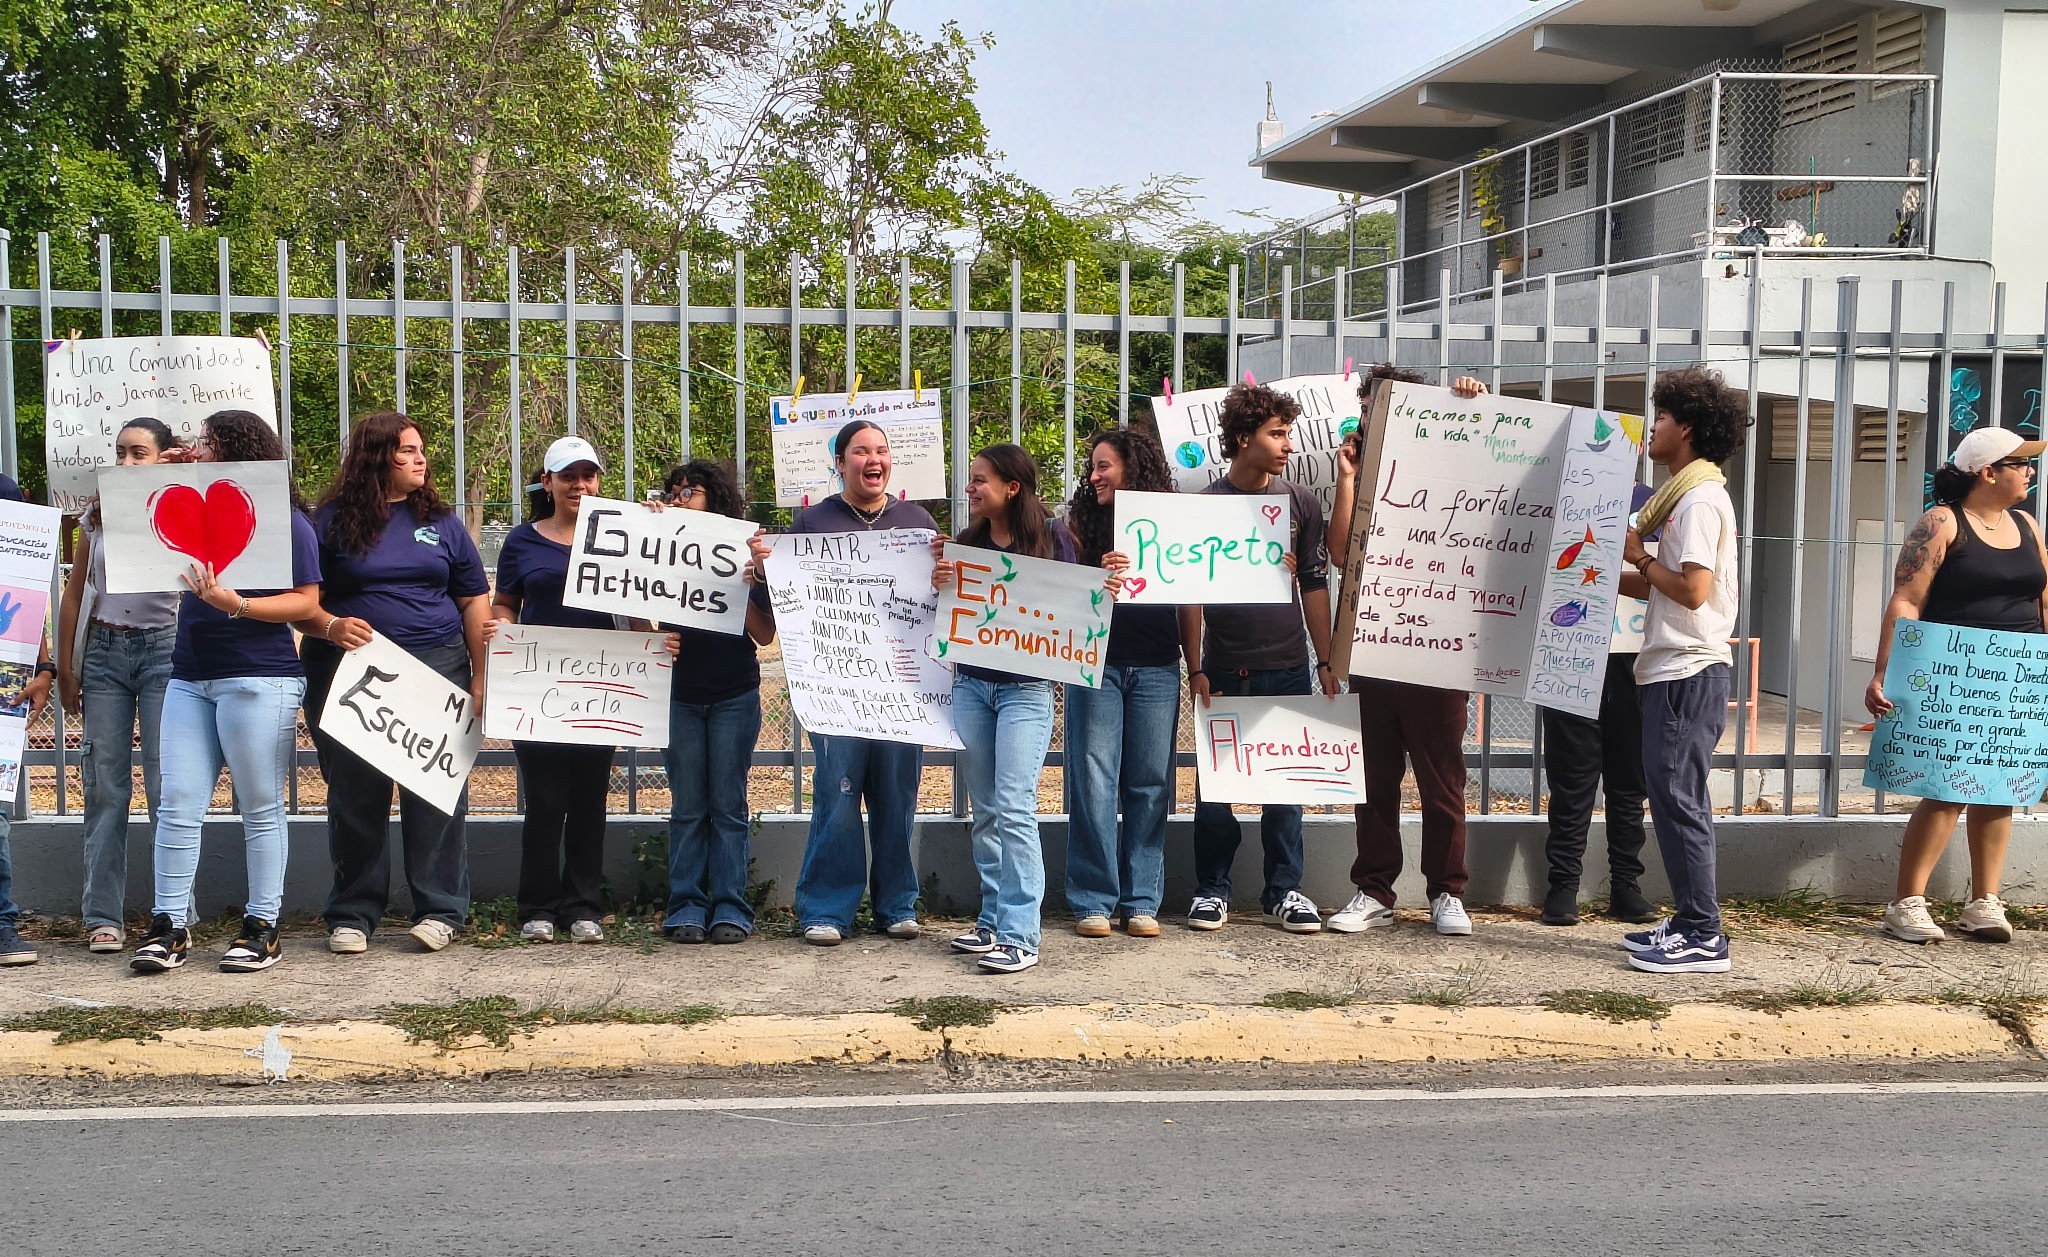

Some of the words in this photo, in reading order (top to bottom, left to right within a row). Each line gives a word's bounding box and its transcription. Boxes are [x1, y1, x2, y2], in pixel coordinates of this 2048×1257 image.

[70, 349, 115, 376] Una
[128, 346, 246, 375] Comunidad
[51, 387, 105, 408] Unida
[52, 419, 85, 438] que
[99, 417, 113, 437] le
[774, 401, 798, 426] Lo
[801, 409, 826, 421] que
[848, 402, 876, 419] gusta
[1390, 391, 1483, 423] ducamos
[1491, 412, 1534, 435] para
[1415, 422, 1430, 440] la
[1562, 459, 1597, 487] Los
[1380, 459, 1428, 512] La
[1440, 483, 1554, 539] fortaleza
[1560, 495, 1624, 523] Pescadores
[583, 509, 738, 578] Guías
[794, 537, 814, 556] LA
[820, 533, 870, 563] ATR
[1407, 525, 1436, 546] una
[1125, 517, 1284, 584] Respeto
[1365, 548, 1414, 570] eside
[1427, 558, 1446, 574] en
[1461, 554, 1476, 578] la
[858, 590, 876, 608] LA
[1358, 605, 1381, 622] de
[809, 619, 852, 642] JUNTOS
[854, 628, 872, 645] LA
[948, 607, 1099, 667] Comunidad
[1946, 628, 1977, 658] Una
[1985, 633, 2032, 660] Escuela
[507, 641, 650, 679] Directora
[1931, 660, 1959, 678] una
[1965, 657, 2008, 683] buena
[540, 687, 622, 719] Carla
[914, 691, 952, 708] SOMOS
[1927, 684, 1939, 702] y
[338, 664, 460, 779] Escuela
[1967, 725, 1984, 738] en
[1208, 716, 1361, 777] Aprendizaje
[1890, 720, 1947, 750] Gracias
[1954, 739, 1978, 755] por
[1881, 741, 1906, 756] día
[1912, 748, 1930, 761] un
[1934, 748, 1963, 770] lugar
